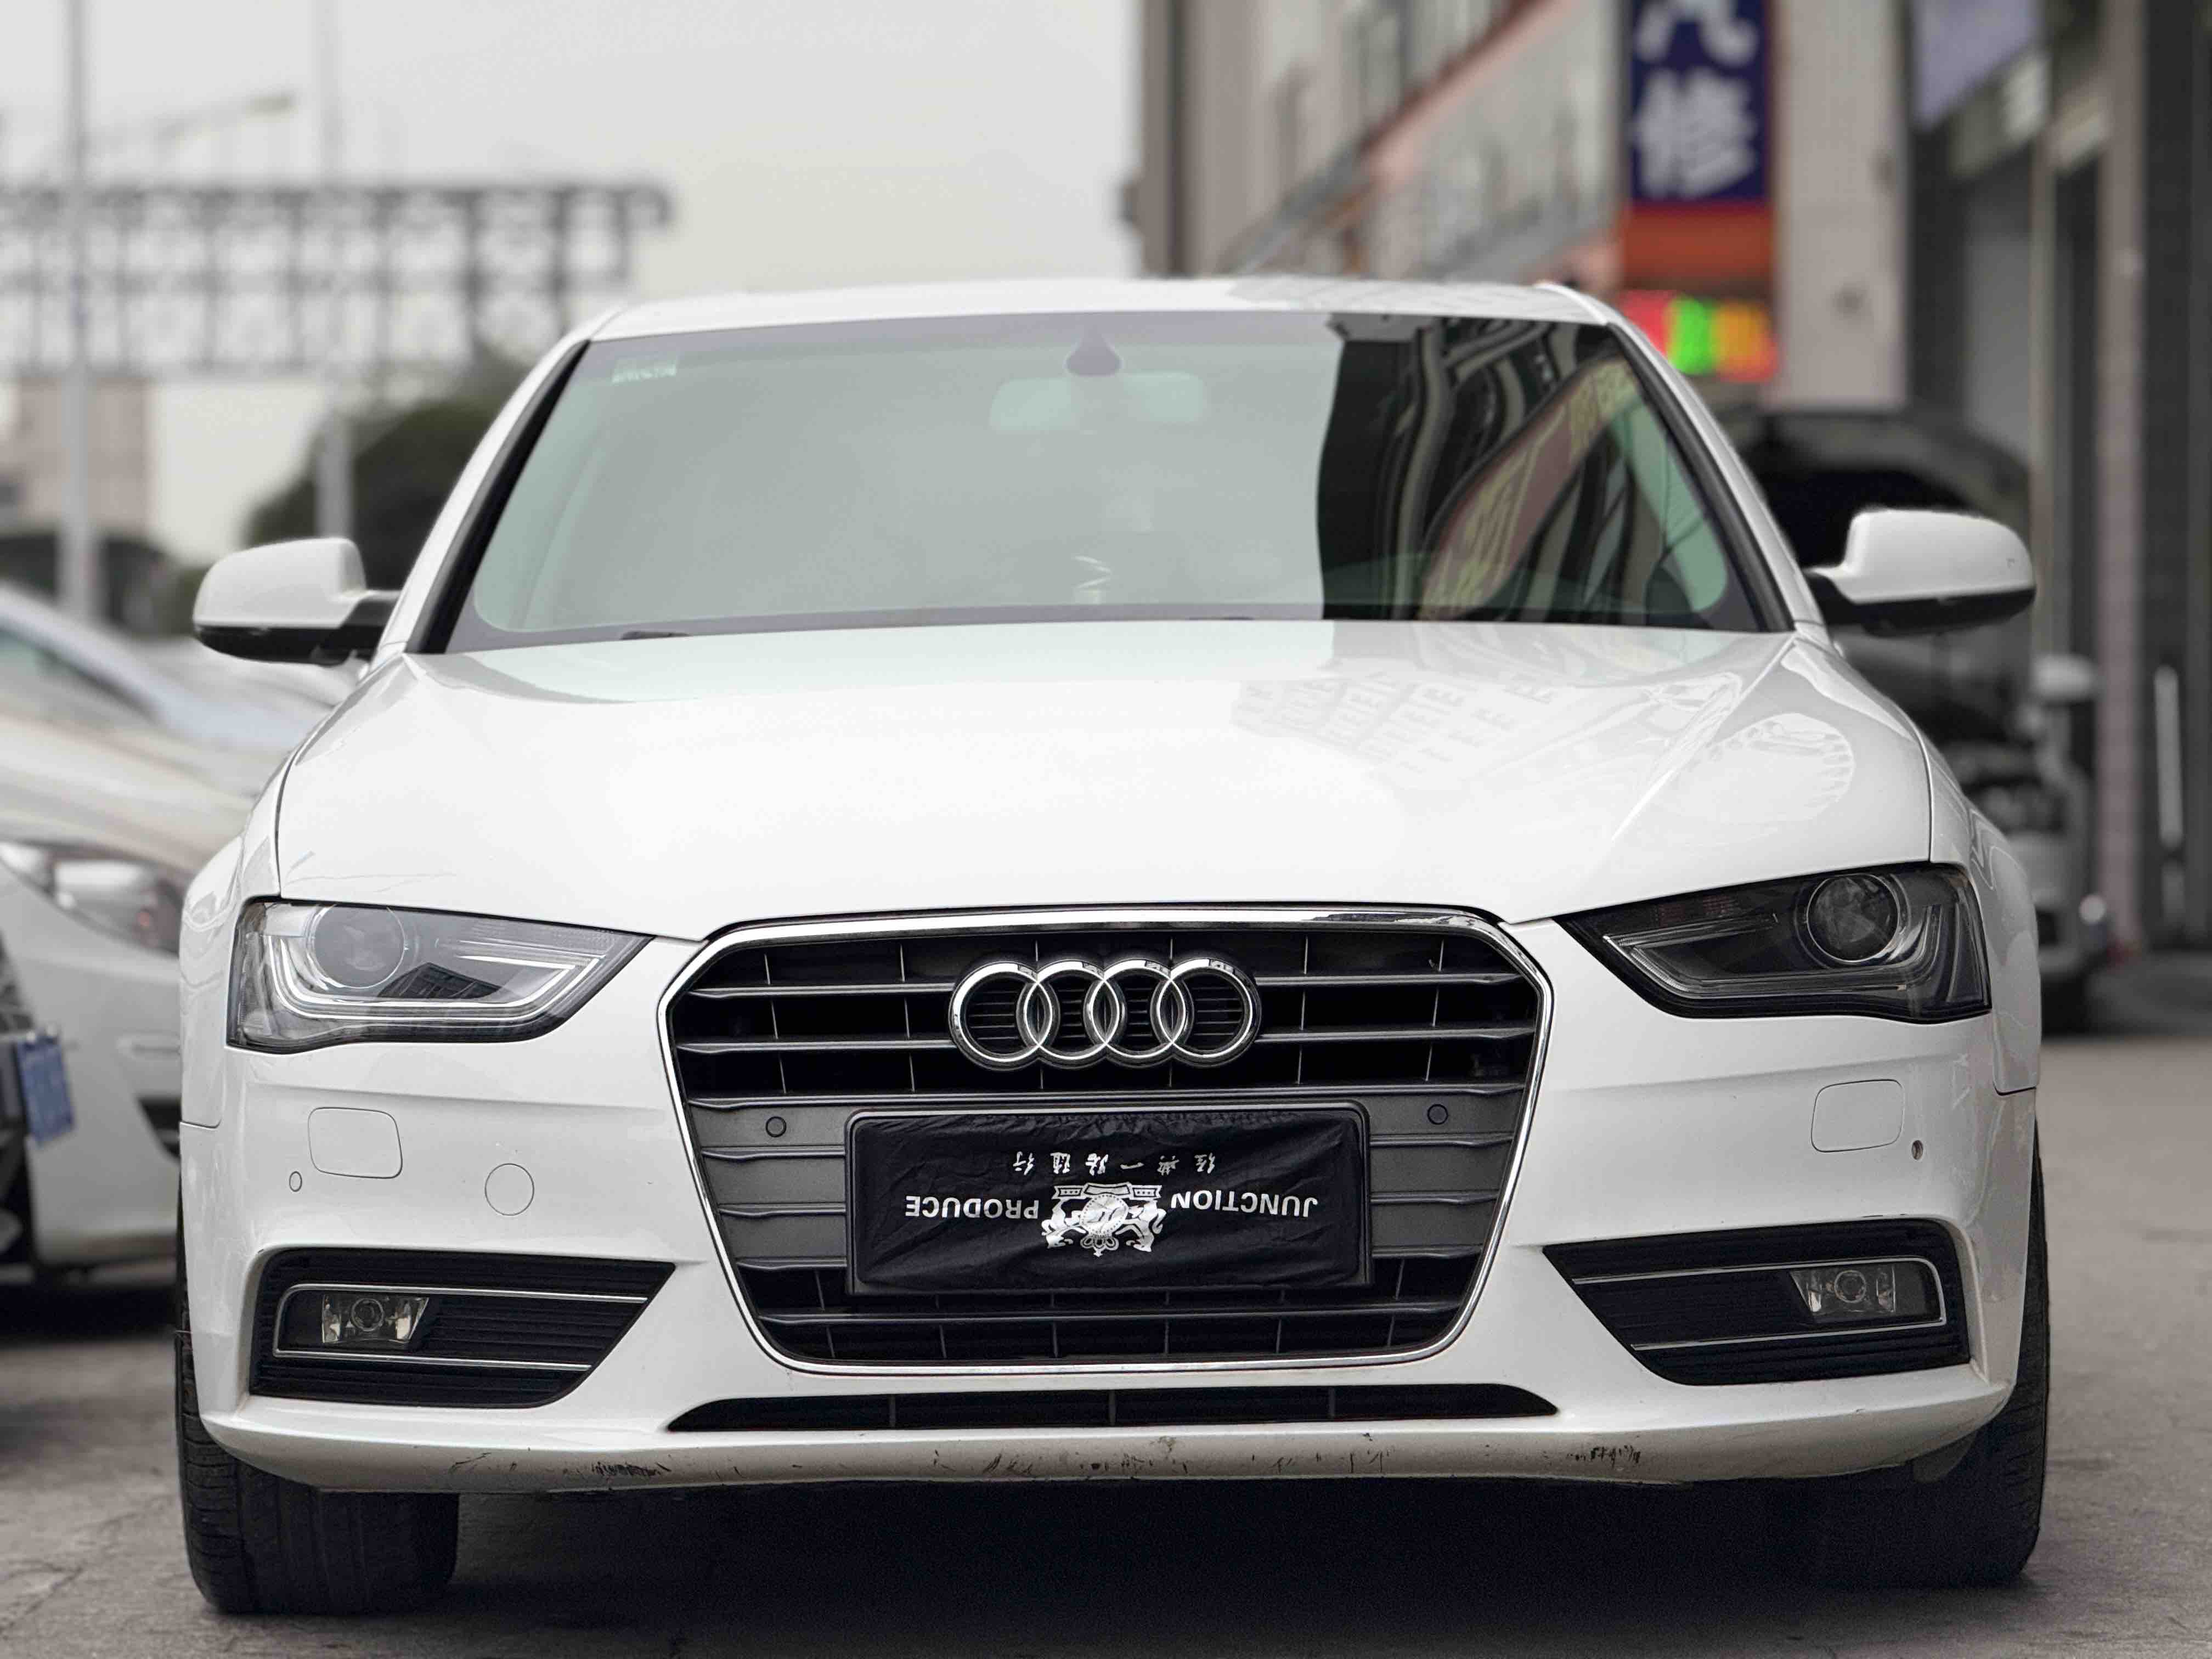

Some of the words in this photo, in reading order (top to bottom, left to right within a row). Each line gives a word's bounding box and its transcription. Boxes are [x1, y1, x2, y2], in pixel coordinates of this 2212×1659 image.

[1013, 1151, 1215, 1176] 经典一路随行
[905, 1195, 1039, 1219] PRODUCE
[1170, 1189, 1318, 1217] JUNCTION
